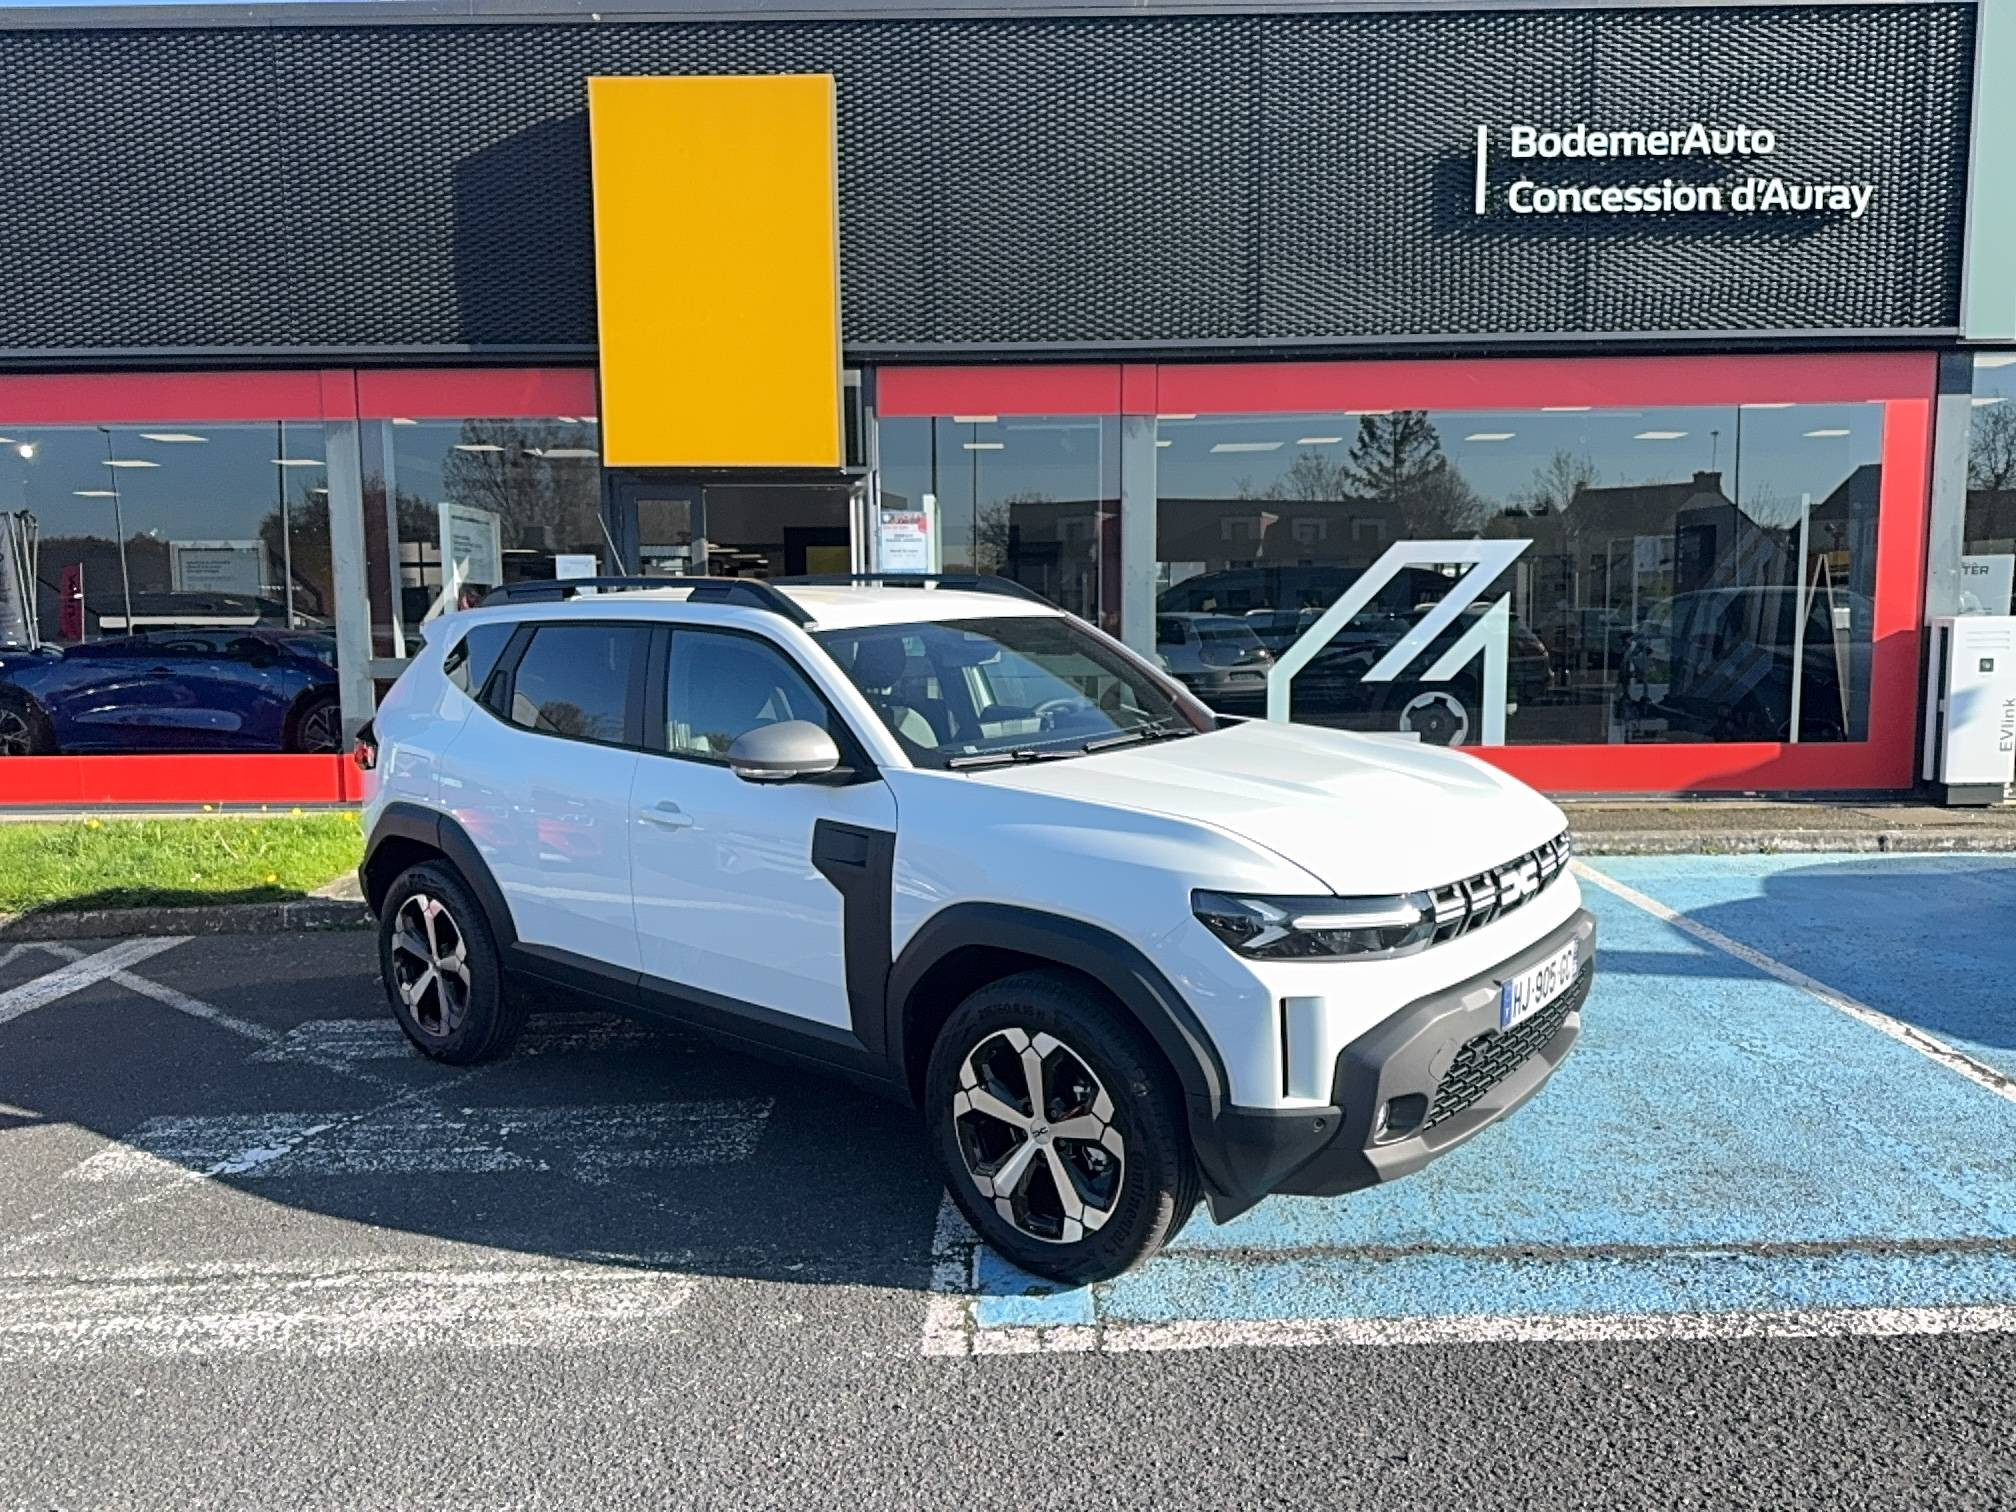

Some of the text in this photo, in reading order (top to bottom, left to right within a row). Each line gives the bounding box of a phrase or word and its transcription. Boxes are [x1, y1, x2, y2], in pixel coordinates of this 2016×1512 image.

[1511, 123, 1775, 158] BodemerAuto
[1508, 178, 1873, 218] Concession d'Auray
[1999, 697, 2016, 753] EVlink
